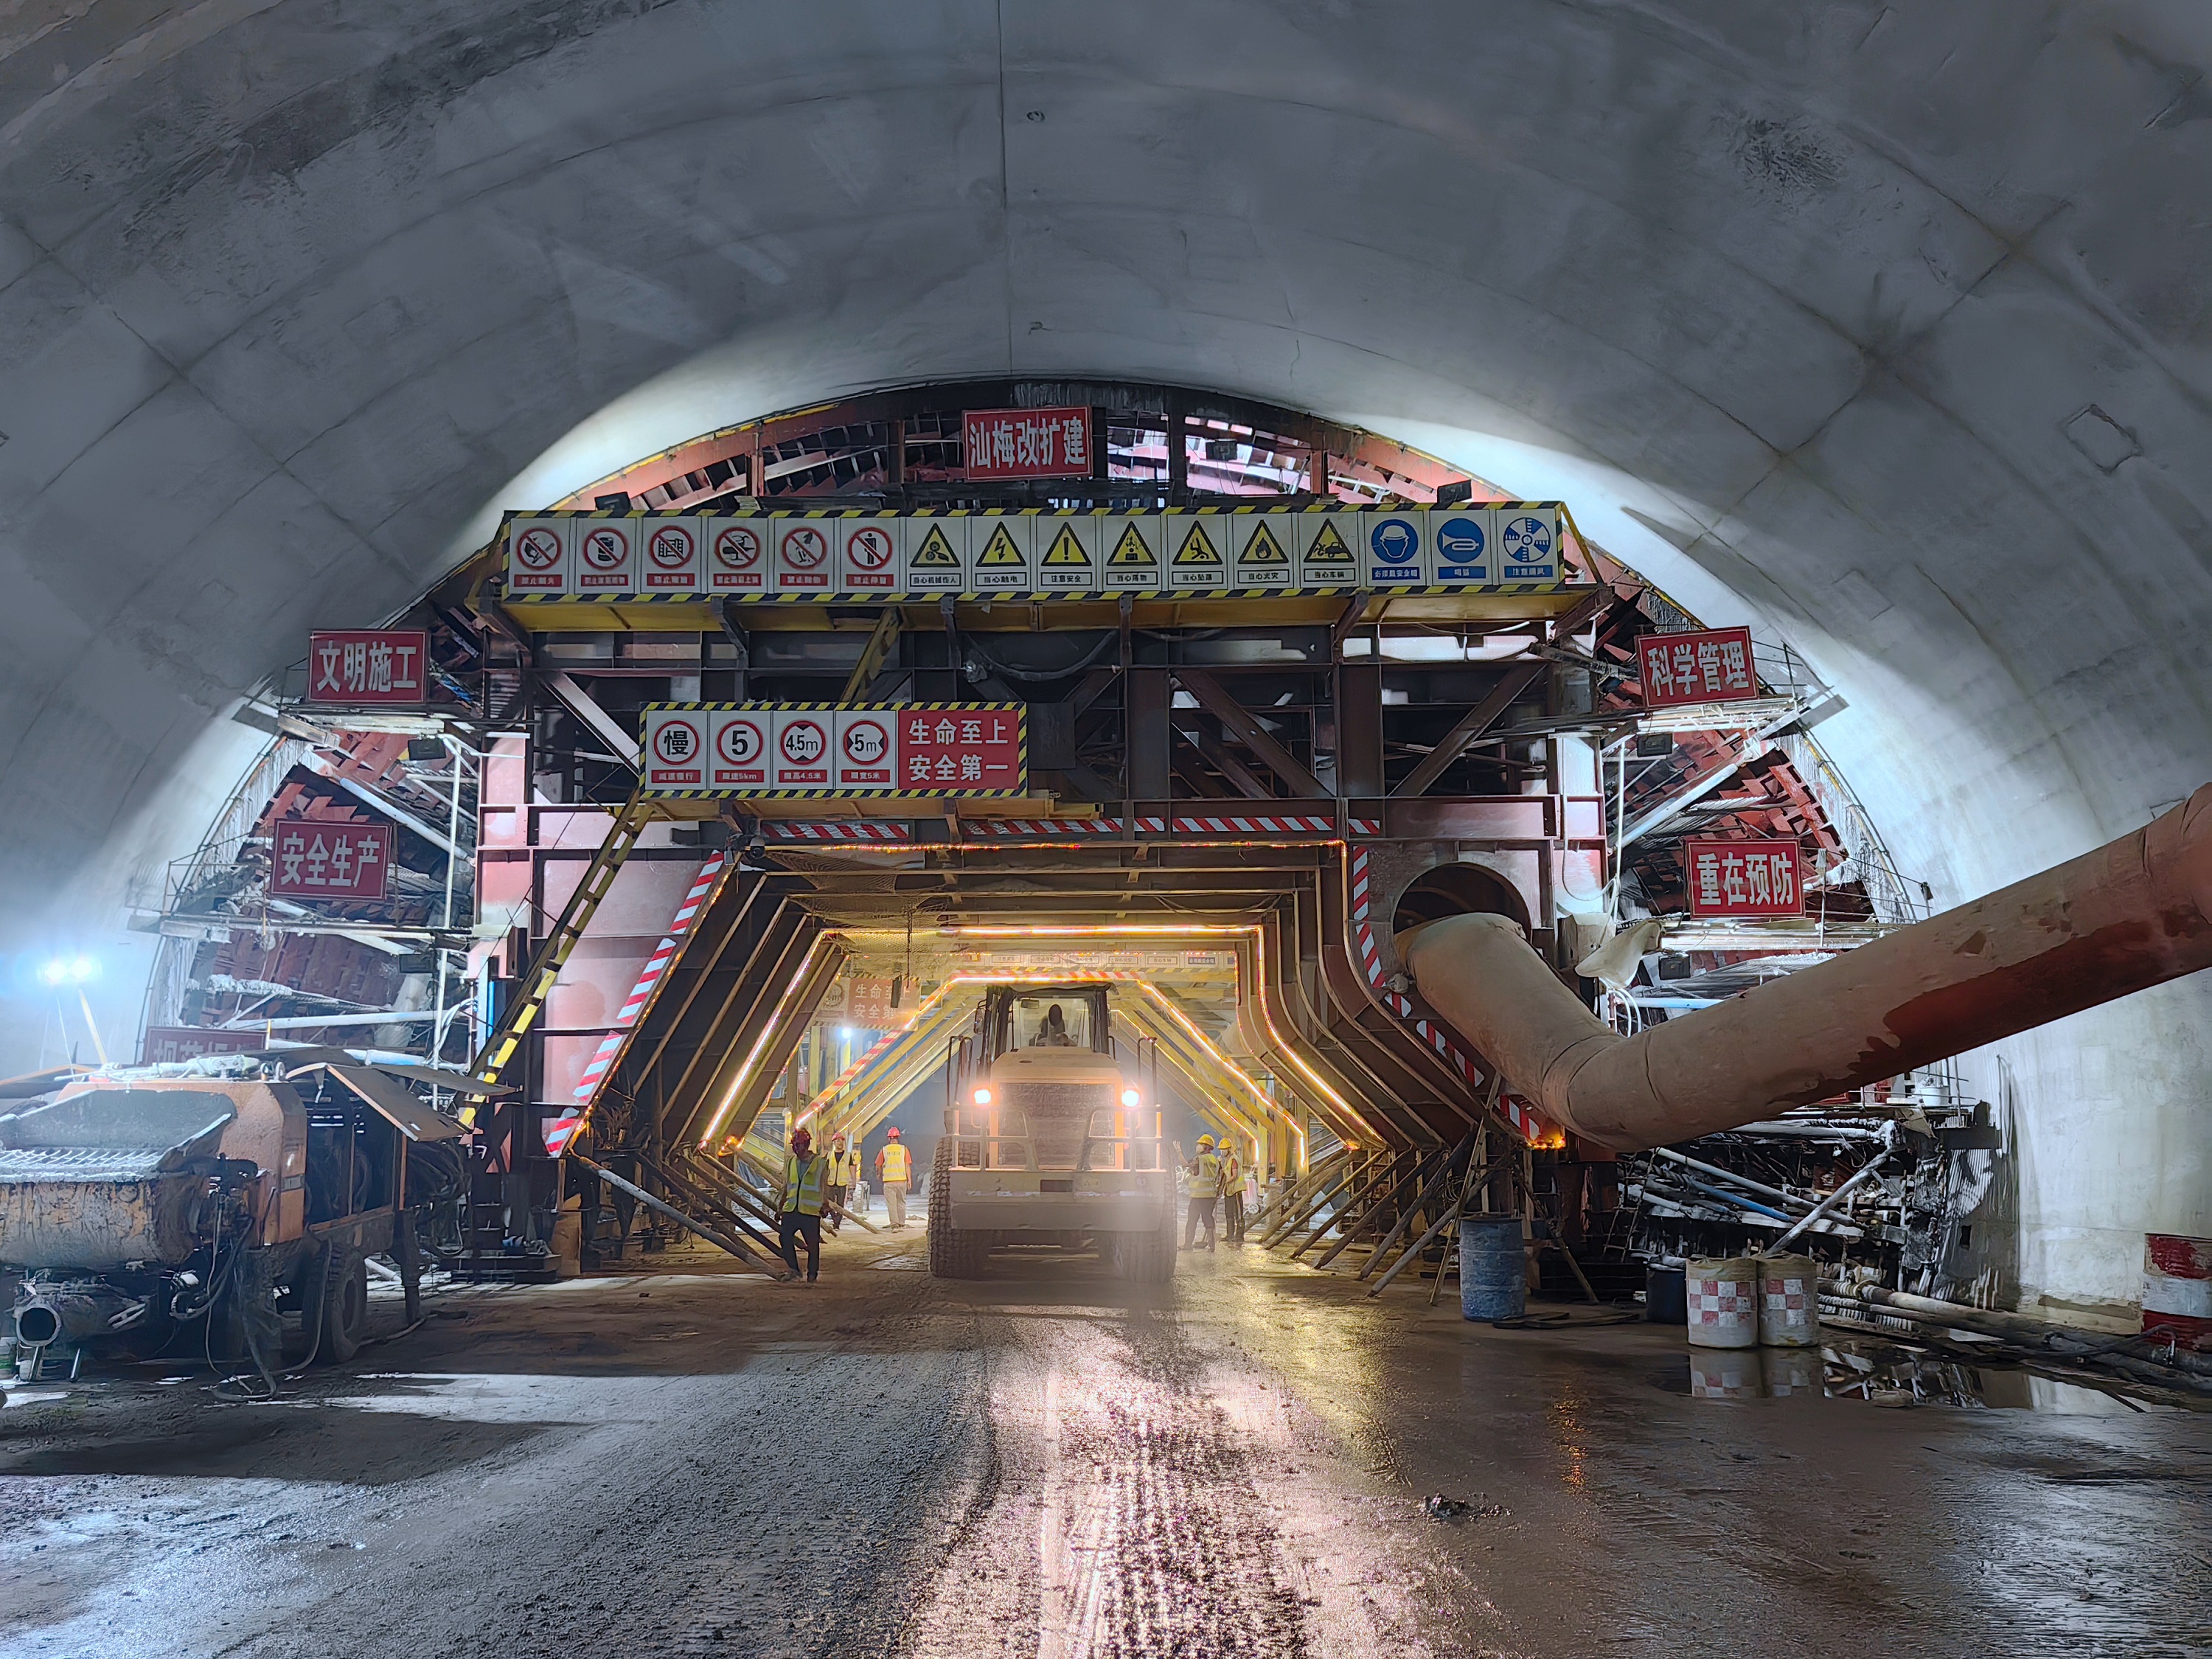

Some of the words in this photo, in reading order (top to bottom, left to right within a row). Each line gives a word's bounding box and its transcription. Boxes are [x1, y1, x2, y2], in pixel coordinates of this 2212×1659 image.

[970, 416, 1086, 469] 汕梅改扩建
[317, 640, 417, 692] 文明施工
[1647, 641, 1749, 696] 科学管理
[664, 730, 689, 755] 慢
[731, 730, 748, 755] 5
[786, 734, 818, 751] 4.5m
[855, 734, 877, 752] 5m
[908, 718, 1008, 745] 生命至上
[908, 754, 1008, 781] 安全第一
[280, 832, 380, 888] 安全生产
[1697, 851, 1794, 906] 重在预防
